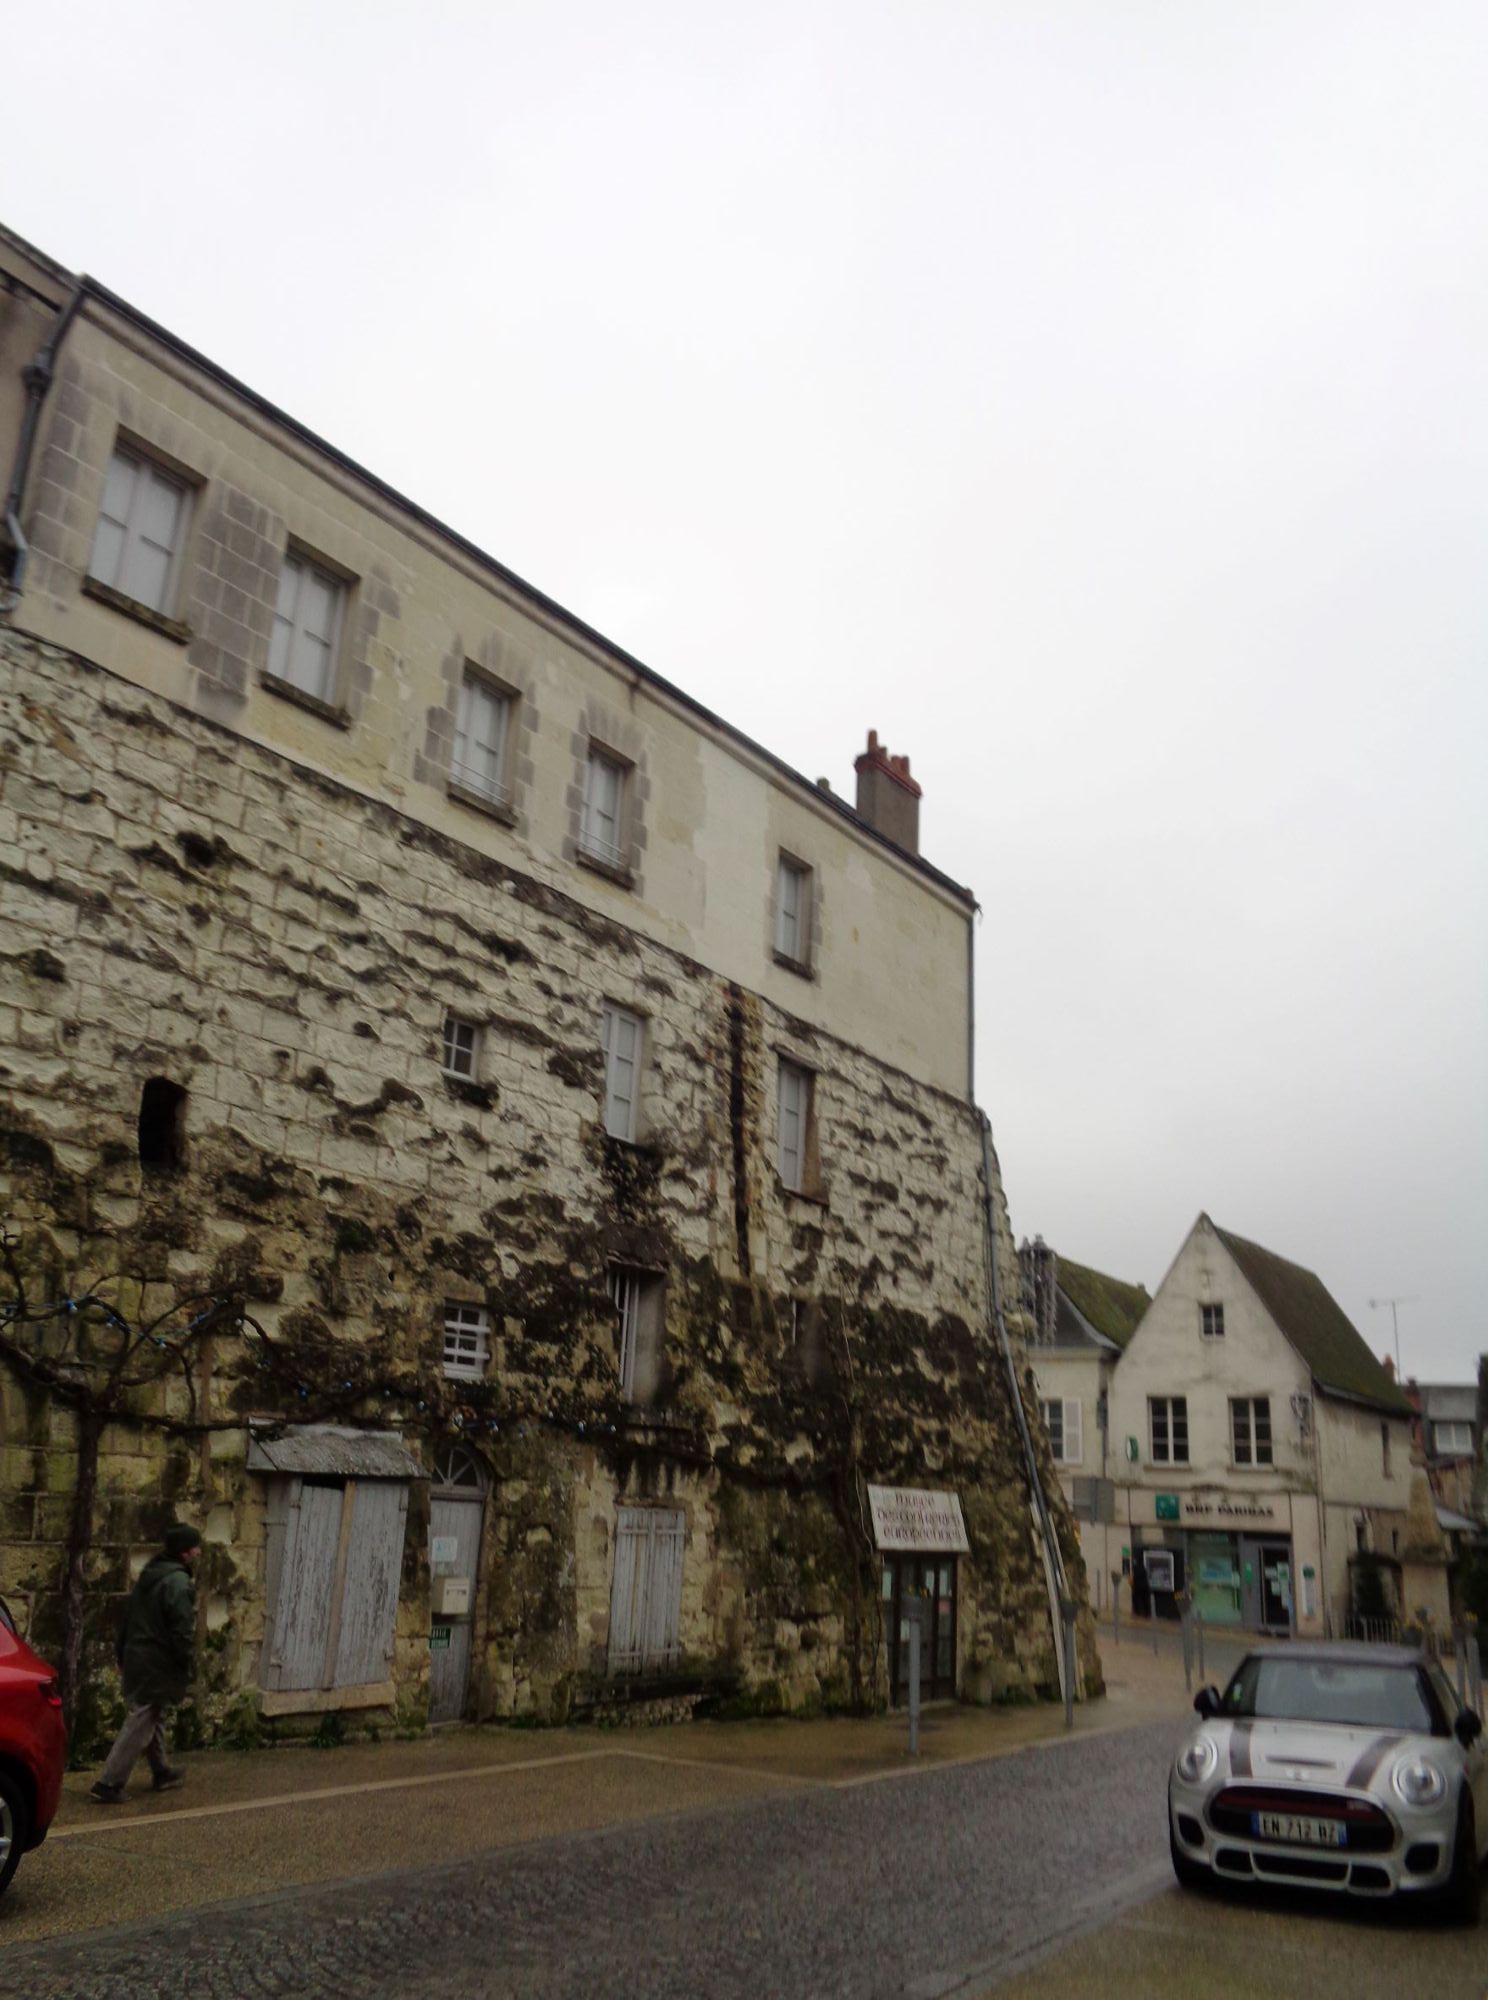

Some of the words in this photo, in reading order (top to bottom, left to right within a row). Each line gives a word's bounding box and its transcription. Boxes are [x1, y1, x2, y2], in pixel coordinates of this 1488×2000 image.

[1185, 1504, 1215, 1515] BNP
[1218, 1504, 1274, 1518] PARIBAS
[1262, 1814, 1280, 1836] EN
